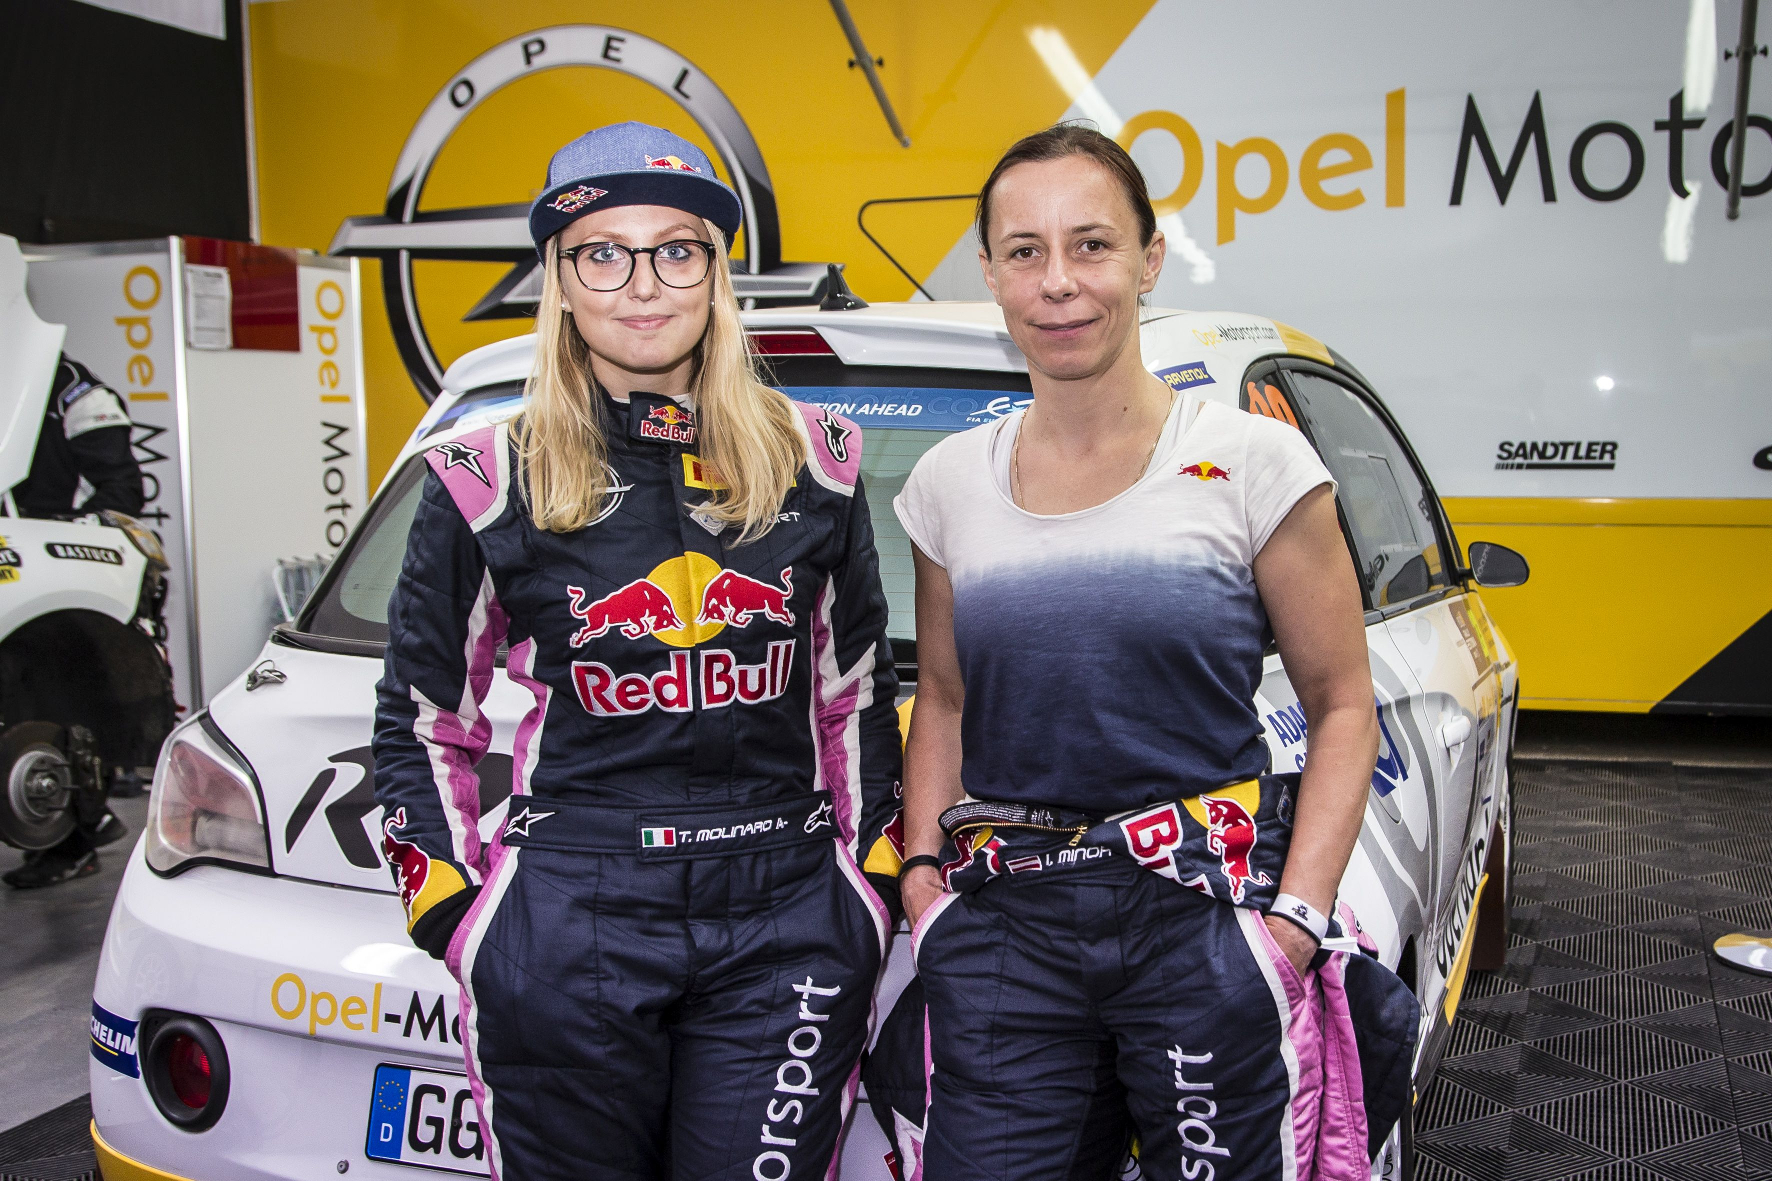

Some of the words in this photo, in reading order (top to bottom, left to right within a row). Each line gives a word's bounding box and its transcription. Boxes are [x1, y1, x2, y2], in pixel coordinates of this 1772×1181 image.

[450, 34, 692, 108] OPEL
[1114, 86, 1406, 246] Opel
[114, 265, 170, 402] Opel
[309, 279, 352, 403] Opel
[856, 403, 923, 416] AHEAD
[1163, 368, 1208, 386] RAVENOL
[641, 420, 670, 439] Red
[670, 424, 696, 443] Bull
[1497, 441, 1618, 461] SANDTLER
[131, 421, 169, 547] Mot
[320, 421, 352, 547] Moto
[53, 544, 119, 563] BASTUCK
[571, 650, 693, 716] Red
[700, 639, 796, 710] Bull
[679, 830, 692, 843] T.
[696, 820, 772, 842] MOLINARO
[752, 975, 842, 1181] orsport
[379, 1122, 393, 1143] D
